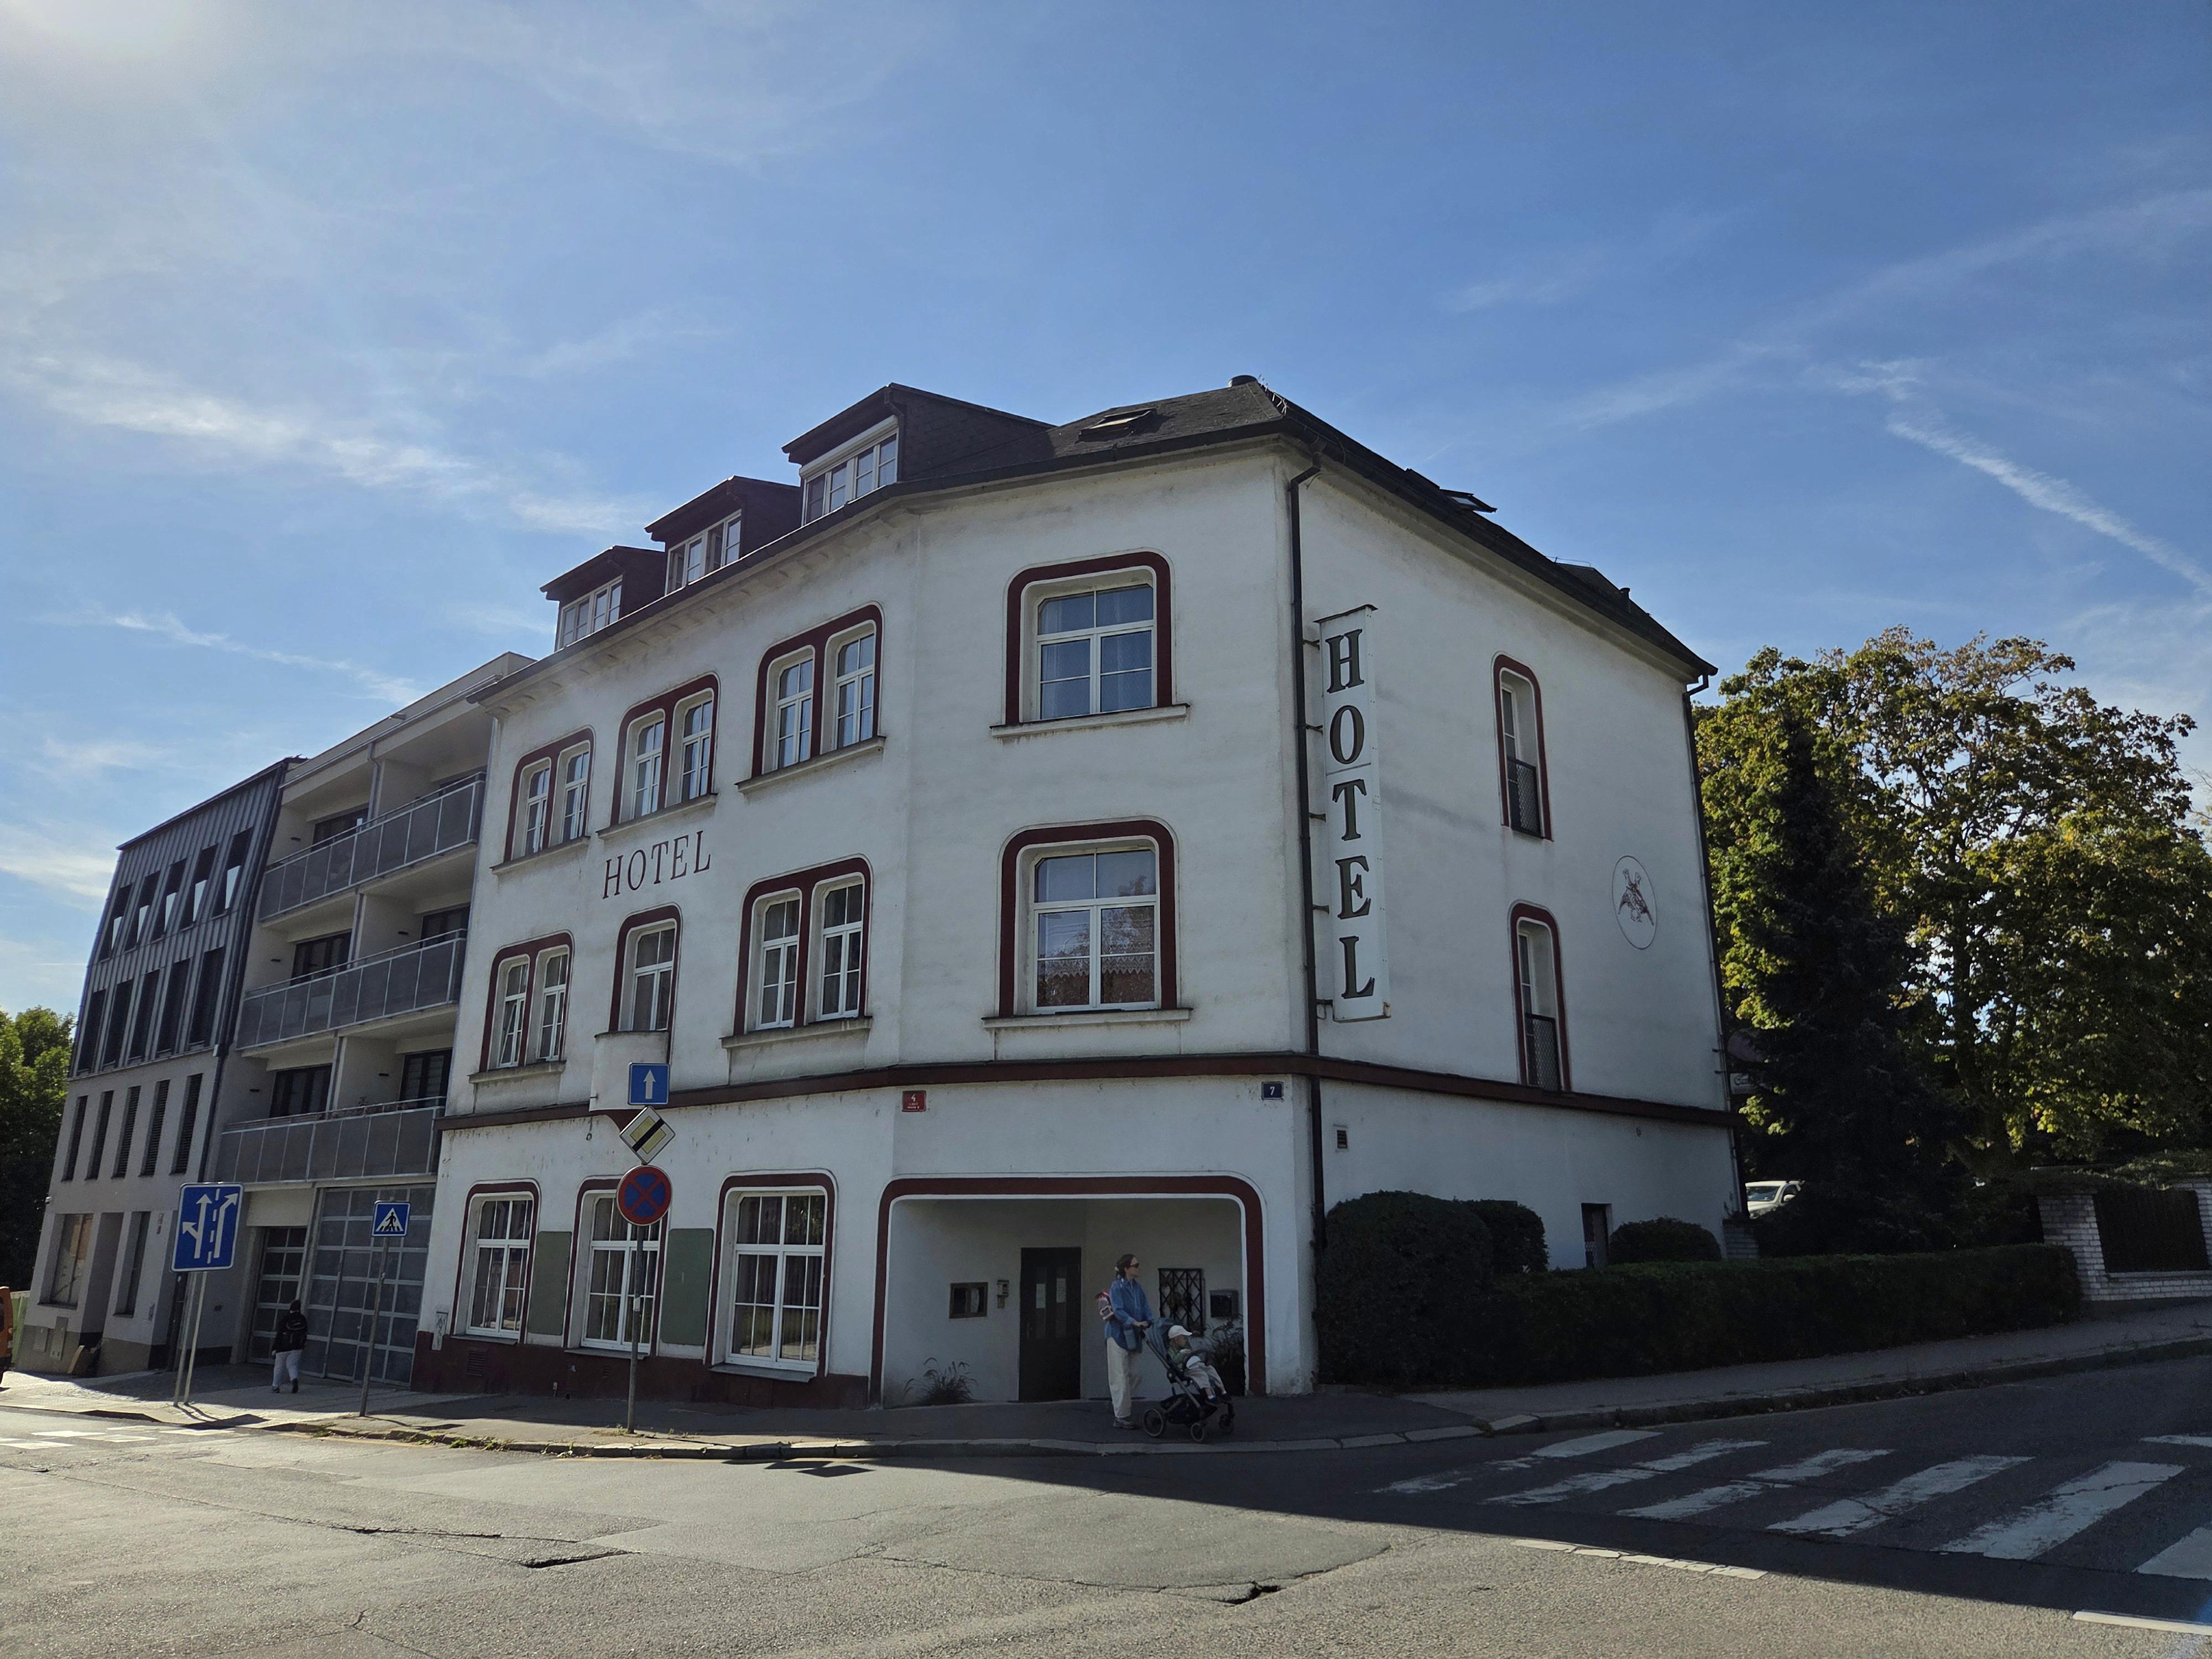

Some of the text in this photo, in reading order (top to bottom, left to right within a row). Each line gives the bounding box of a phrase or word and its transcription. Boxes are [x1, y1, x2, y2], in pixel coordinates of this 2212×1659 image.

[1325, 628, 1375, 999] HOTEL
[602, 830, 711, 899] HOTEL
[1270, 1086, 1275, 1096] 7
